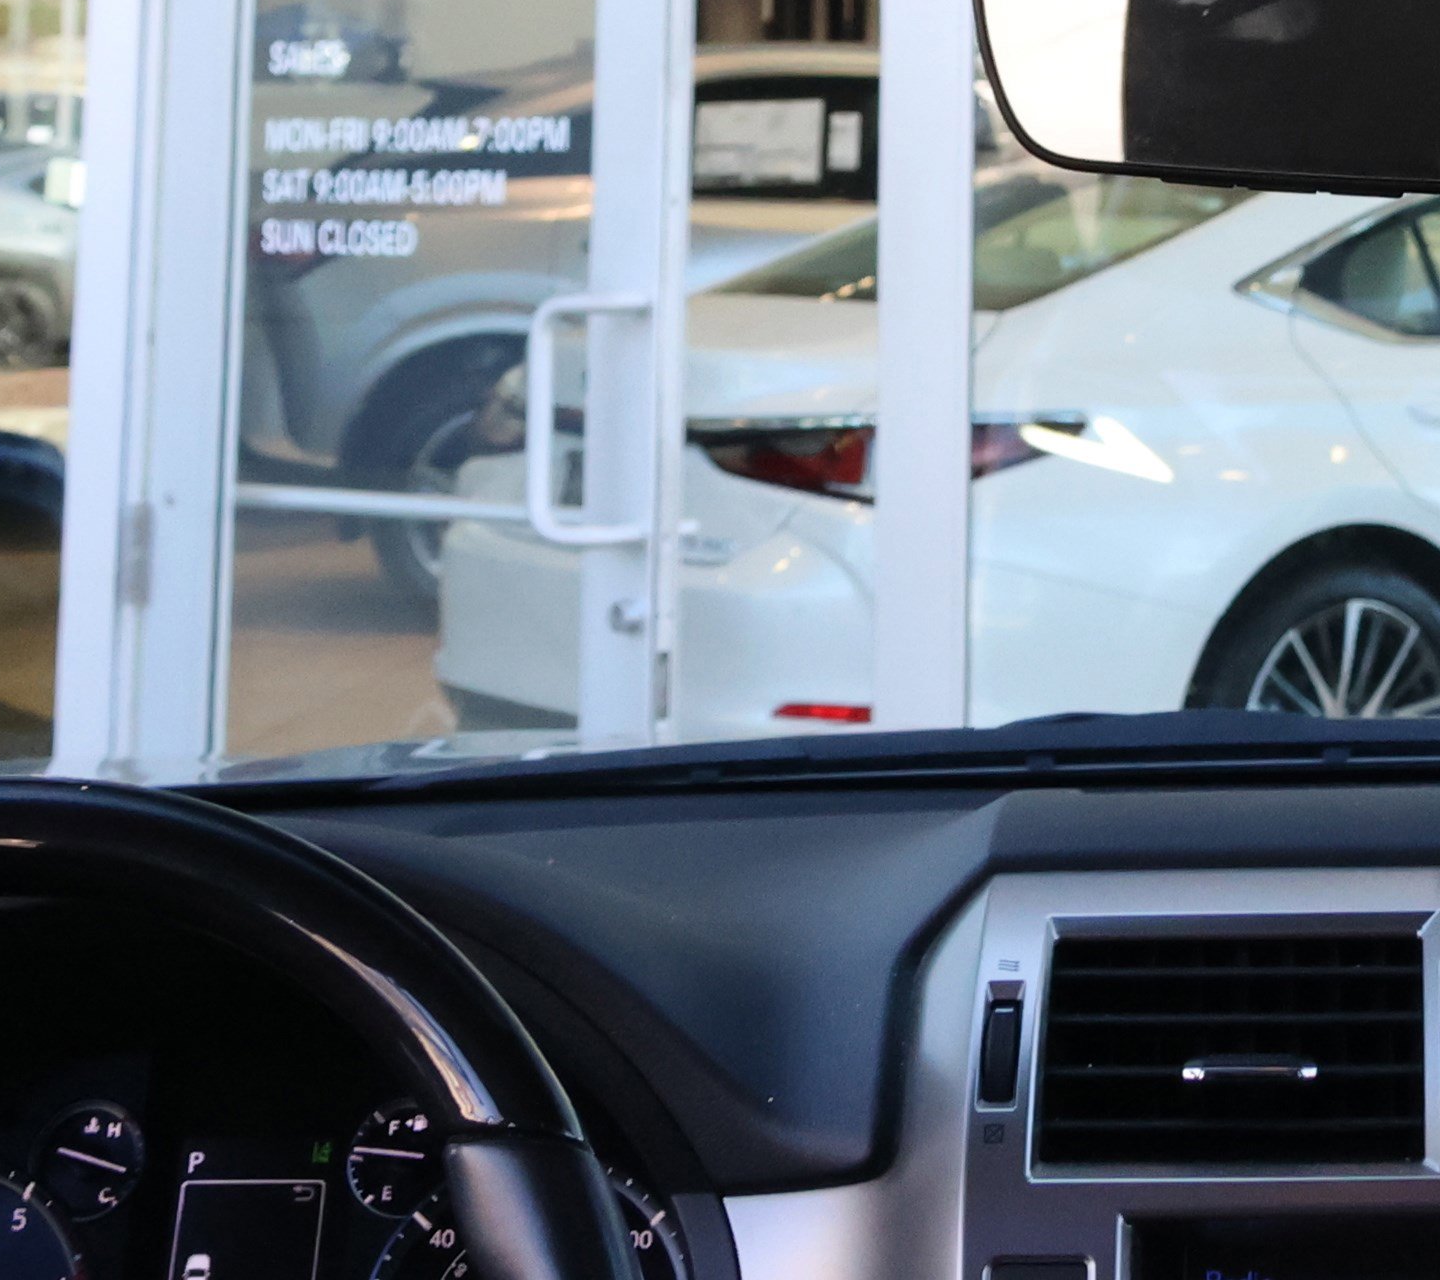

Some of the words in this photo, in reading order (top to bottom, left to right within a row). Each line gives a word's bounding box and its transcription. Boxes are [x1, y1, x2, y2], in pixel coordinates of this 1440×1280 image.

[264, 115, 368, 153] MON-FRI
[262, 168, 309, 204] SAT
[260, 217, 314, 255] SUN
[317, 218, 418, 256] CLOSED
[107, 1122, 123, 1139] H
[388, 1119, 401, 1137] F
[187, 1150, 206, 1174] P
[380, 1184, 393, 1202] E
[11, 1206, 28, 1231] 5
[429, 1228, 456, 1249] 40
